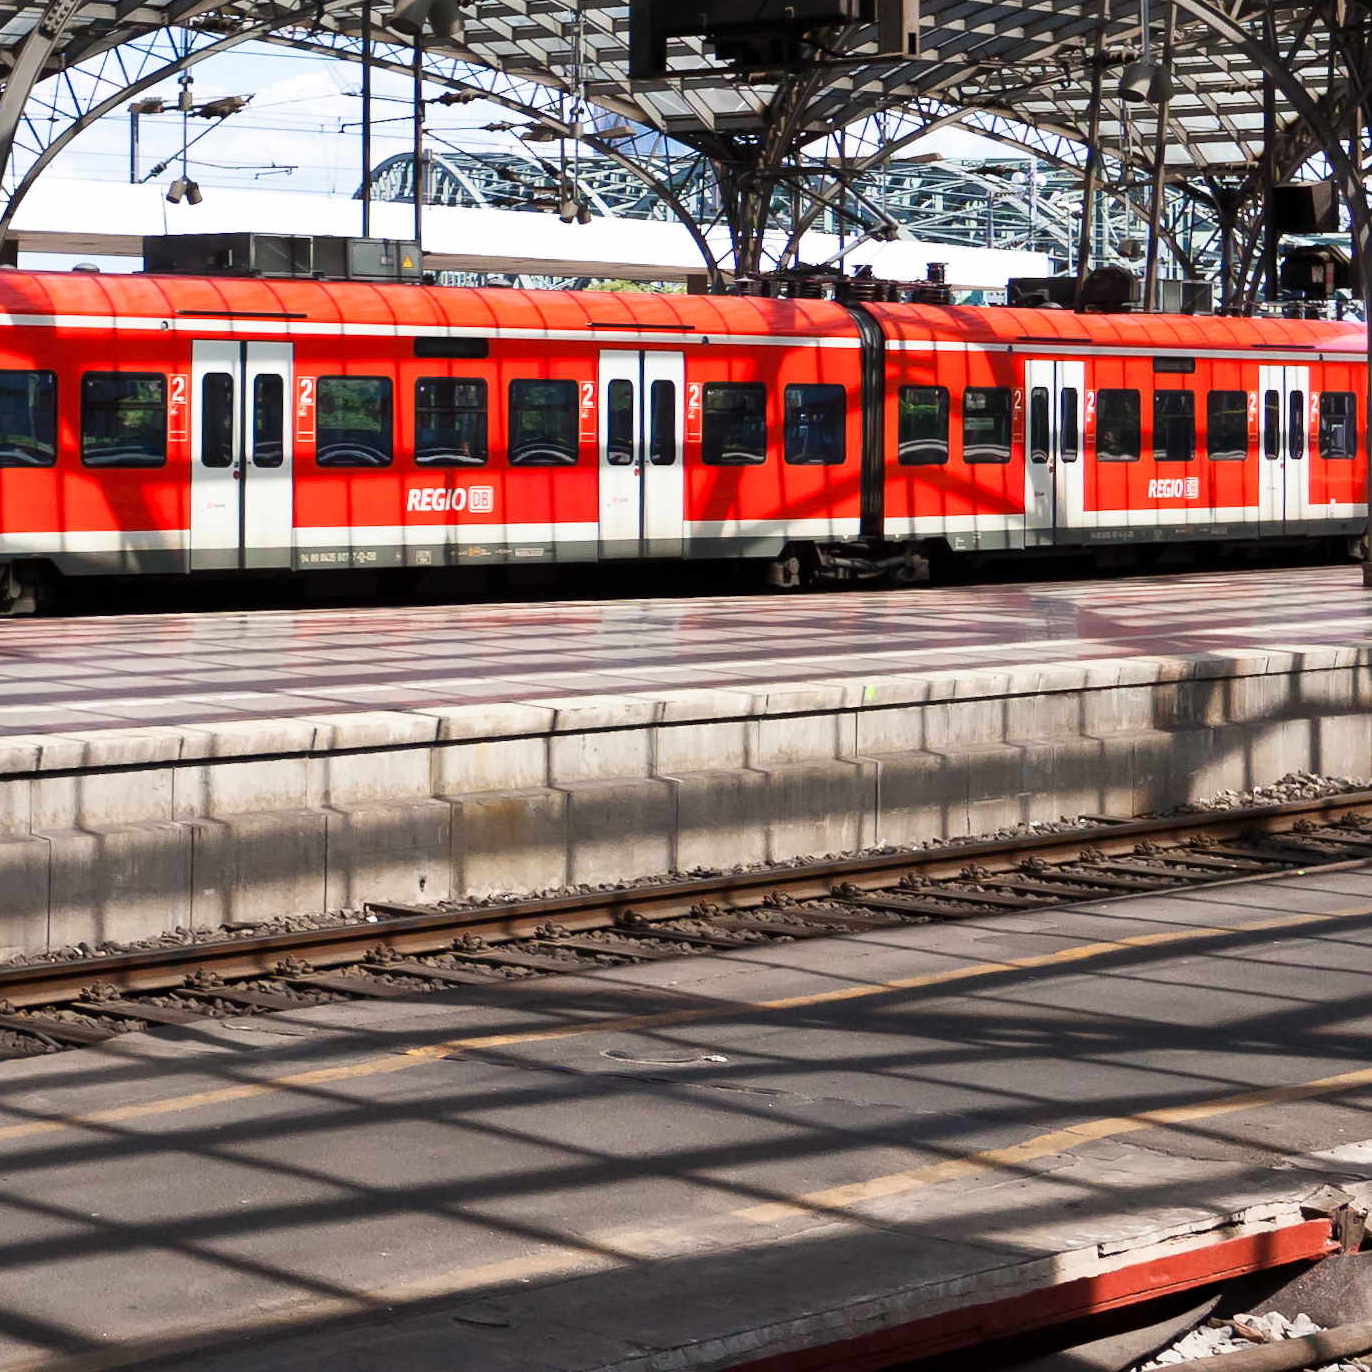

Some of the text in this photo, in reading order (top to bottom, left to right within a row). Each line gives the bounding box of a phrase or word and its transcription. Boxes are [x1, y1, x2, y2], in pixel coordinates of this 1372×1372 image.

[171, 376, 186, 403] 2
[299, 378, 314, 404] 2
[581, 383, 594, 406] 2
[688, 384, 700, 407] 2
[1014, 389, 1022, 409] 2
[1087, 391, 1096, 411] 2
[1249, 393, 1257, 413] 2
[1311, 394, 1319, 413] 2
[407, 488, 467, 511] REGIO
[1148, 479, 1184, 499] REGIO
